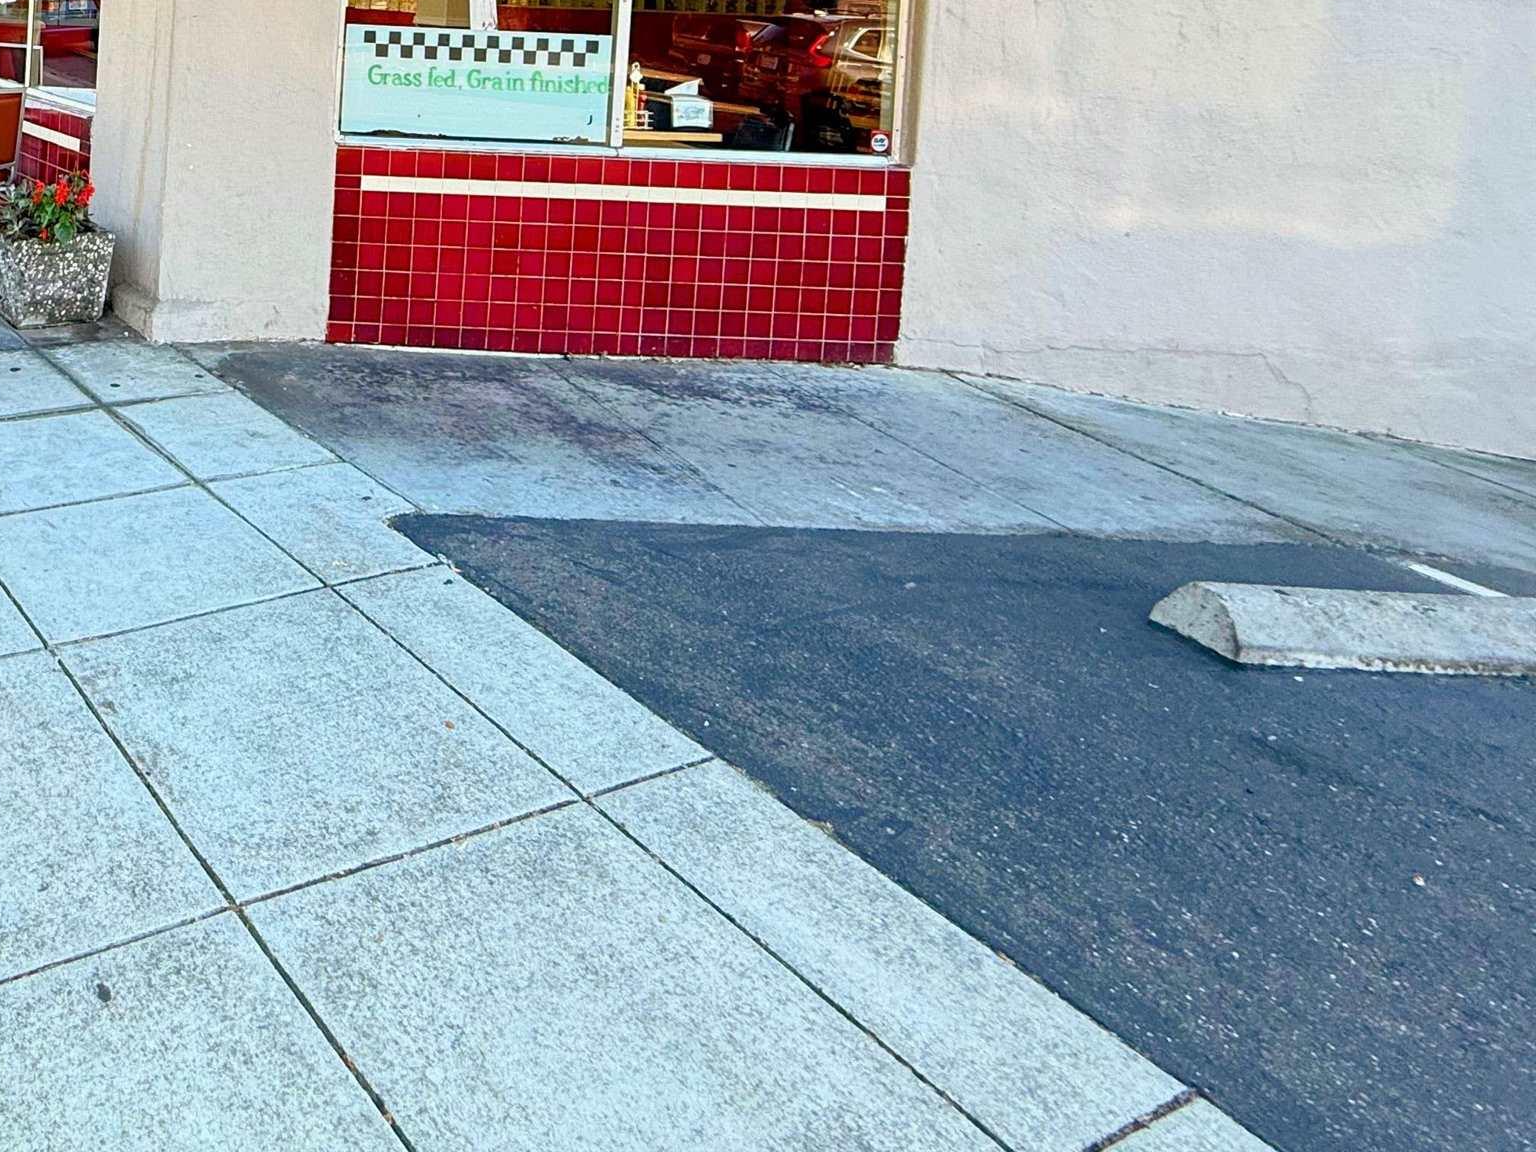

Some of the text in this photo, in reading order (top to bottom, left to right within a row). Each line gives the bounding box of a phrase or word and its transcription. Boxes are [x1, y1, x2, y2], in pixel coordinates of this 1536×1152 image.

[367, 64, 422, 88] Grass
[466, 69, 524, 92] Grain
[529, 70, 609, 95] finished
